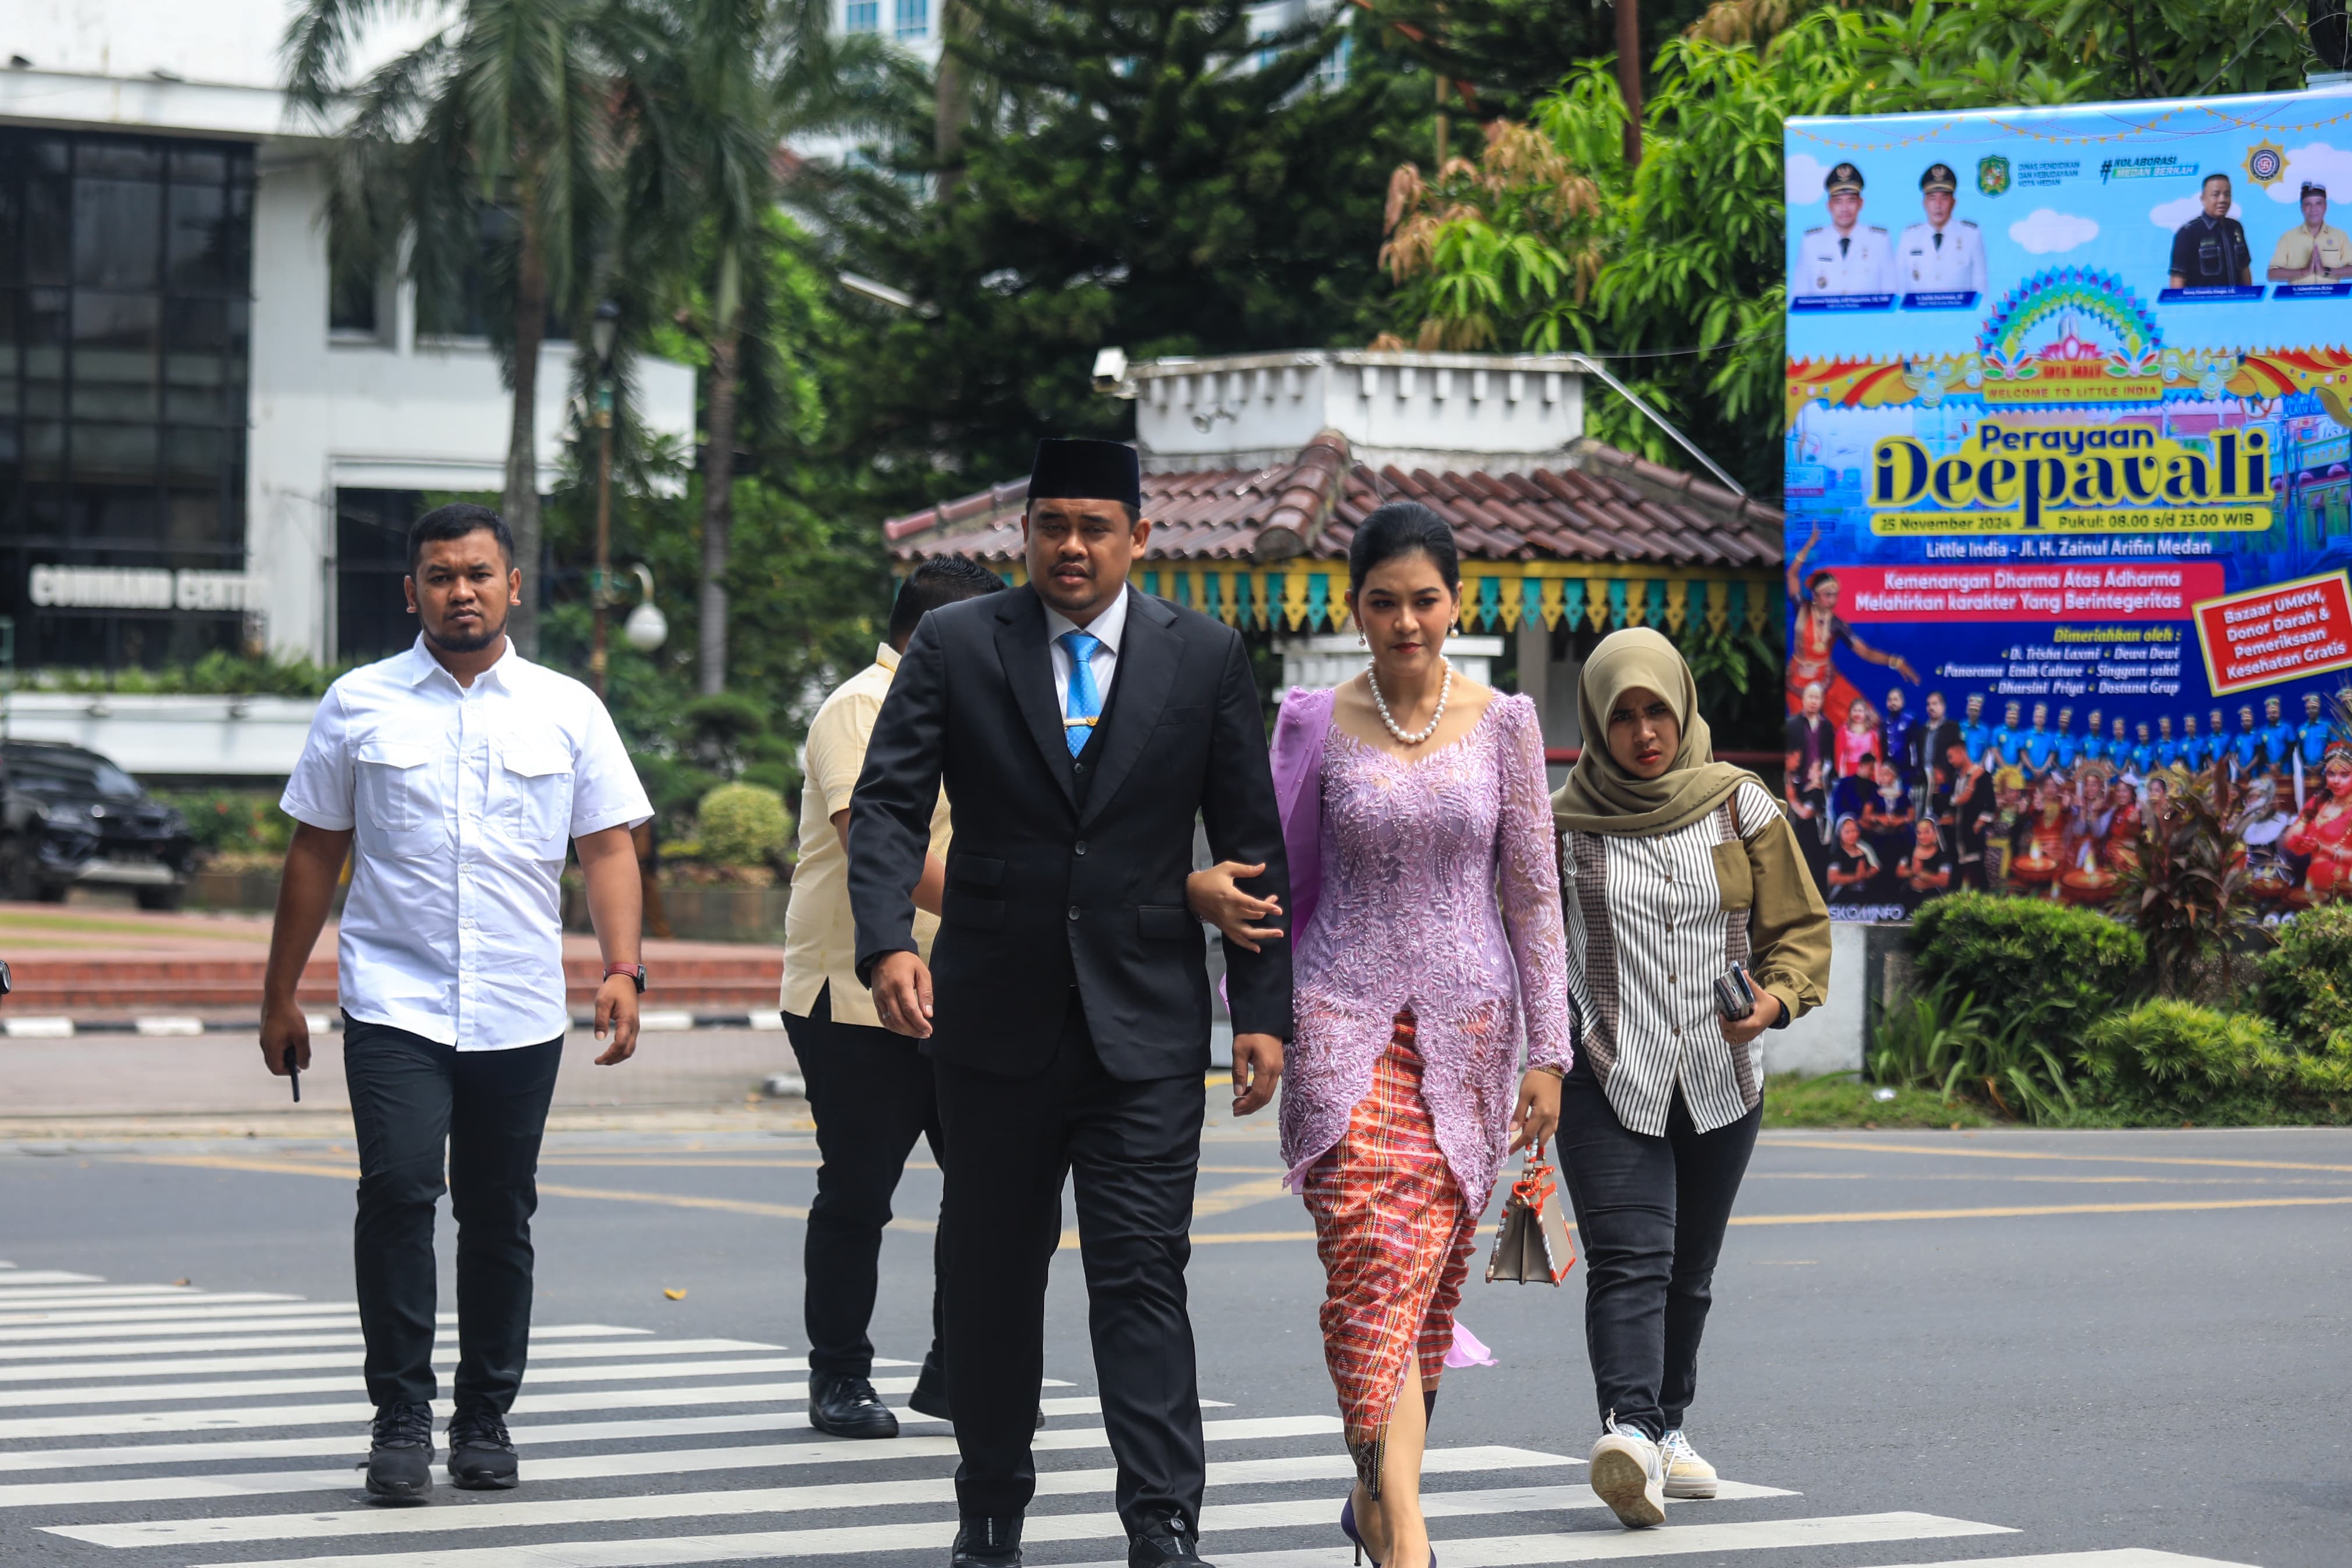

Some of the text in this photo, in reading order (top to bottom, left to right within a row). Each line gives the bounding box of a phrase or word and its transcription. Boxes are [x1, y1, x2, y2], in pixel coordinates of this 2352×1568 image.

[2153, 166, 2194, 176] BERKAH
[1988, 386, 2157, 399] WELCOME TO LITTLE INDIA
[1981, 426, 2154, 455] Perayaan
[1877, 433, 2269, 529] Deepavali
[1880, 513, 2254, 530] 25 November 2024 Pukul: 08.00 s/d 23.00 WIB
[1926, 542, 1965, 558] Little
[1969, 542, 2006, 557] India
[2019, 541, 2035, 557] Jl.
[2040, 542, 2055, 556] H.
[2059, 541, 2106, 556] Zainul
[2111, 539, 2153, 556] Arifin
[2157, 539, 2211, 555] Medan
[1884, 570, 2180, 593] Kemenangan Dharma Atas Adharma
[1855, 592, 2180, 614] Melahirkan karakter Yang Berintegeritas
[2224, 590, 2325, 624] Bazaar UMKM,
[2053, 628, 2141, 643] Dimeriahkan
[2143, 626, 2173, 642] oleh
[2226, 607, 2330, 642] Donor Darah &
[2026, 645, 2061, 660] Trisha
[2063, 645, 2101, 660] Laxmi
[2113, 644, 2147, 660] Dewa
[2149, 643, 2181, 659] Dewi
[2234, 628, 2327, 659] Pemeriksaan
[1944, 662, 2005, 678] Panorama
[2040, 661, 2083, 677] Culture
[2097, 661, 2147, 680] Singgam
[2150, 660, 2180, 676] sakti
[2226, 641, 2347, 680] Kesehatan Gratis
[1998, 680, 2049, 695] Dharsini
[2052, 679, 2085, 697] Priya
[2150, 678, 2180, 696] Grup
